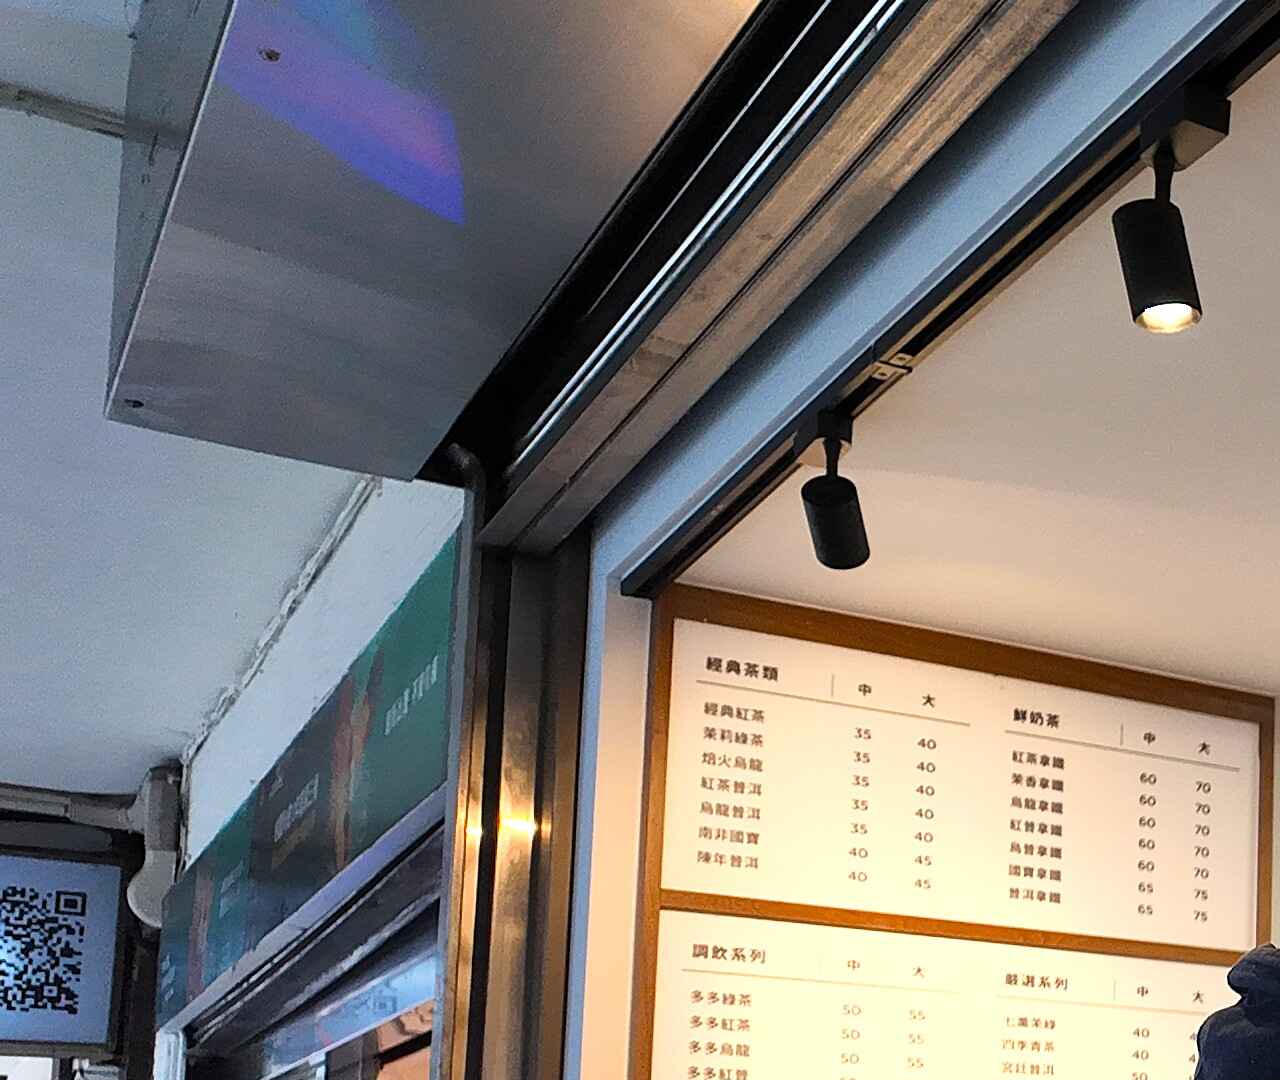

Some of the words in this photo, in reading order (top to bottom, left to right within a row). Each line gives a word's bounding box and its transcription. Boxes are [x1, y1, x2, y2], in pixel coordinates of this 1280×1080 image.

[706, 656, 779, 681] 經典茶類
[859, 684, 872, 697] 中
[922, 694, 936, 708] 大
[704, 702, 765, 723] 經典紅茶
[853, 728, 872, 740] 35
[917, 738, 937, 750] 40
[1013, 708, 1061, 729] 鮮奶茶
[1144, 732, 1156, 745] 中
[1198, 742, 1211, 755] 大
[853, 751, 871, 764] 35
[916, 761, 936, 774] 40
[852, 775, 870, 788] 35
[915, 785, 935, 797] 40
[1139, 772, 1157, 785] 60
[1195, 781, 1211, 794] 70
[700, 777, 762, 796] 紅茶普洱
[851, 799, 868, 812] 35
[915, 808, 935, 821] 40
[1139, 795, 1156, 807] 60
[1195, 803, 1210, 815] 70
[850, 823, 868, 835] 35
[914, 832, 934, 844] 40
[1138, 816, 1156, 829] 60
[1194, 824, 1210, 837] 70
[848, 848, 868, 859] 40
[914, 855, 932, 867] 45
[1138, 838, 1155, 851] 60
[1194, 846, 1210, 858] 70
[1137, 860, 1155, 872] 60
[1193, 868, 1209, 880] 70
[848, 871, 868, 883] 40
[914, 879, 932, 891] 45
[1137, 882, 1154, 894] 65
[1193, 889, 1208, 901] 75
[1137, 904, 1153, 916] 65
[1193, 911, 1208, 922] 75
[691, 943, 766, 965] 調飲系列
[842, 1004, 862, 1017] 50
[689, 1015, 751, 1032] 多多紅茶
[841, 1029, 861, 1041] 50
[1132, 1027, 1150, 1039] 40
[840, 1053, 860, 1065] 50
[1132, 1050, 1149, 1061] 40
